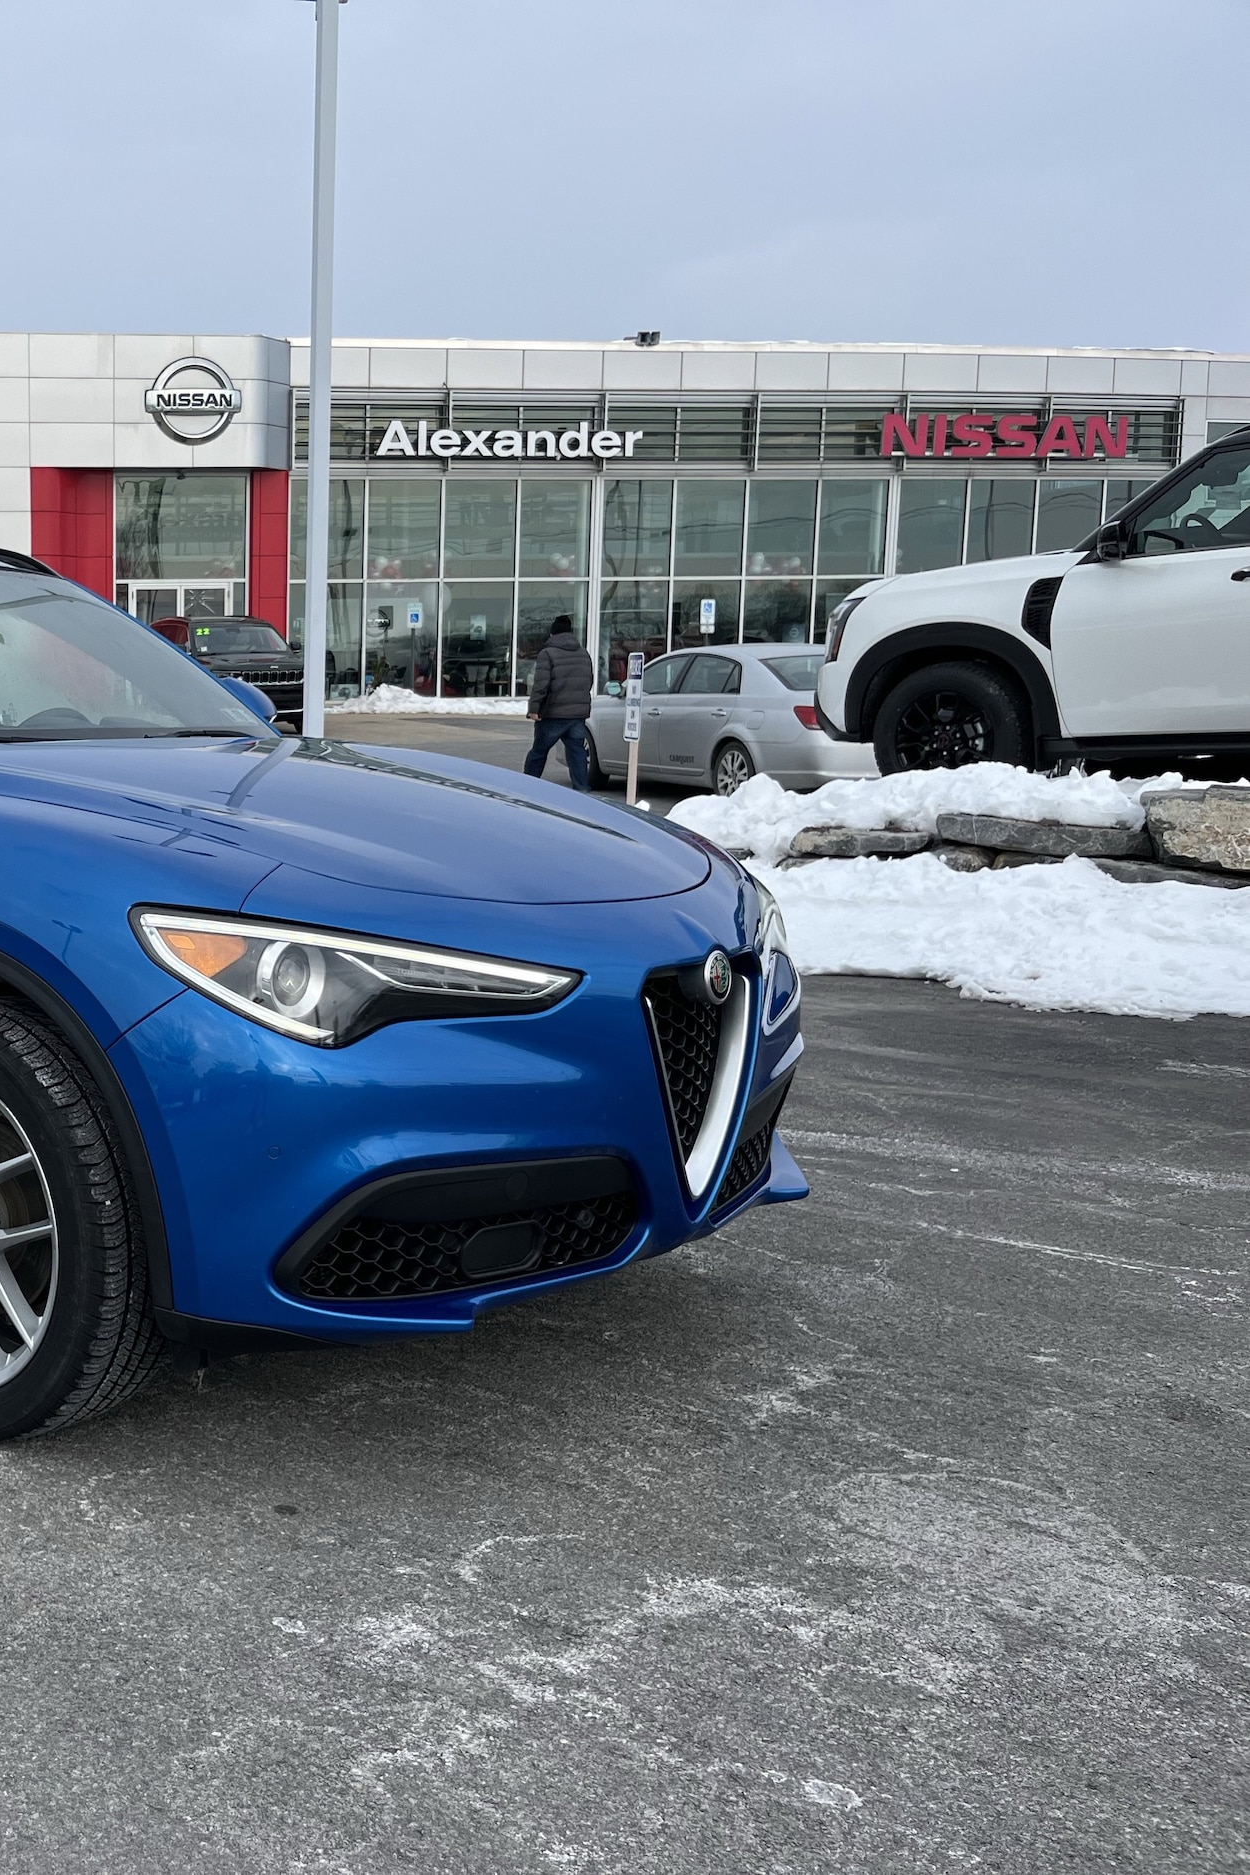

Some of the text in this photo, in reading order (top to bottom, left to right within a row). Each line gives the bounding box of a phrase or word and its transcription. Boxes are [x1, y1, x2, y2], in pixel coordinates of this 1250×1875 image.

[156, 393, 232, 407] NISSAN
[376, 413, 1128, 457] Alexander NISSAN
